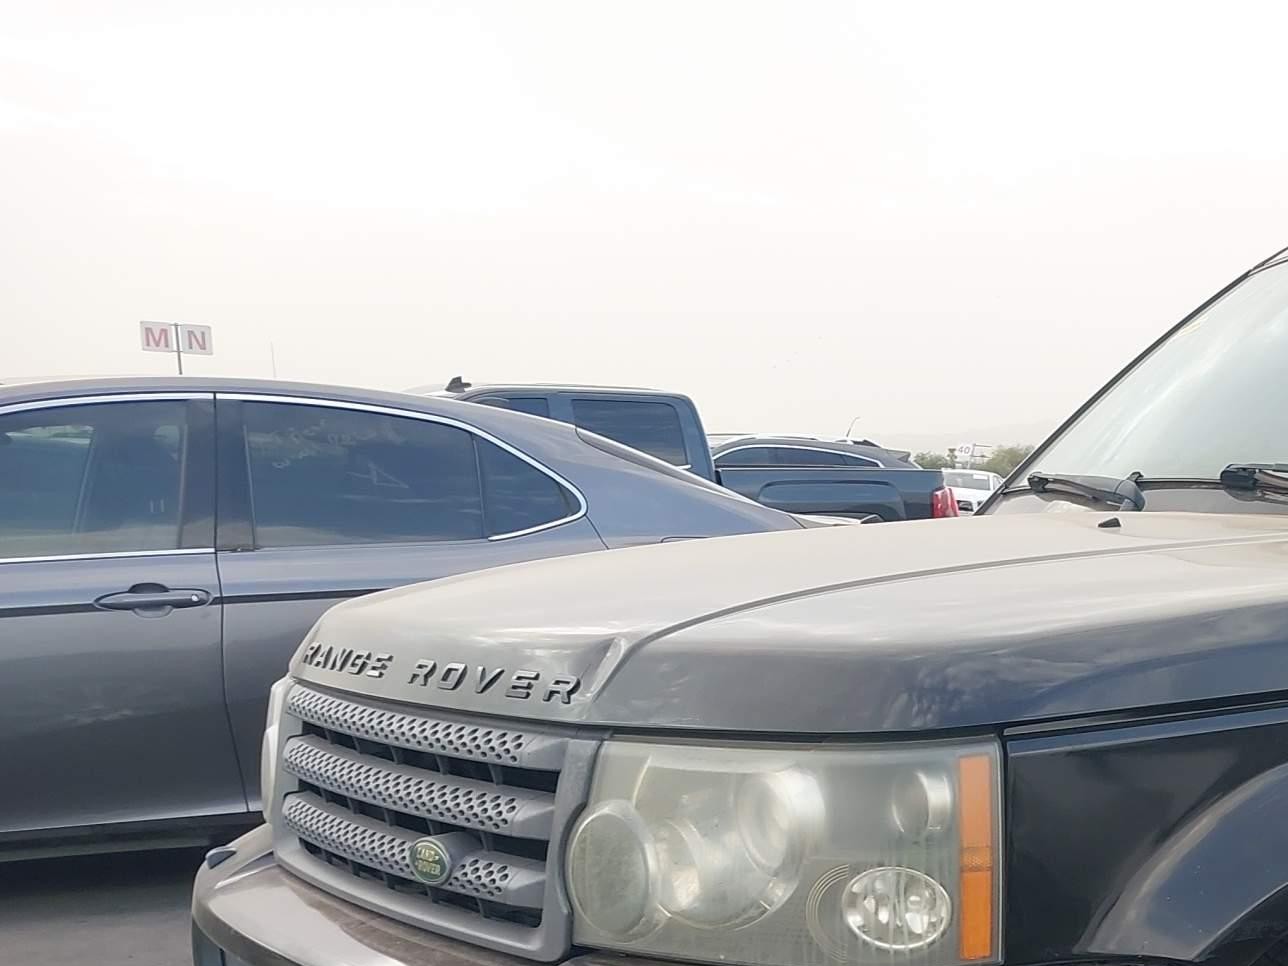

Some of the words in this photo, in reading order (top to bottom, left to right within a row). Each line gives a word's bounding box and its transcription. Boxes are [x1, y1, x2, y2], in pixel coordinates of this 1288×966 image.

[144, 326, 169, 348] M
[187, 329, 207, 350] N
[302, 641, 394, 679] RANGE
[407, 658, 581, 705] ROVER
[417, 859, 441, 876] ROVER
